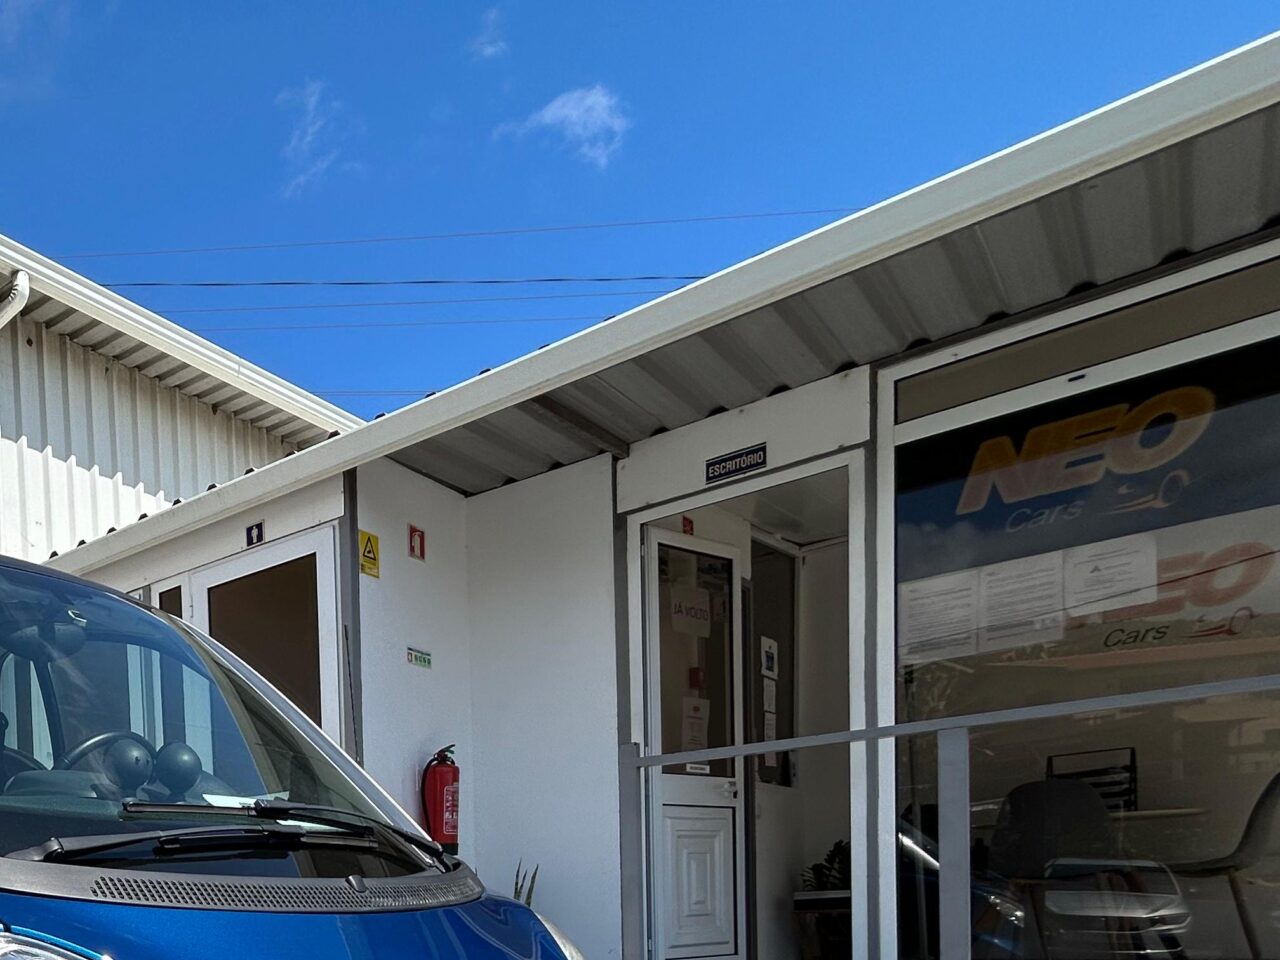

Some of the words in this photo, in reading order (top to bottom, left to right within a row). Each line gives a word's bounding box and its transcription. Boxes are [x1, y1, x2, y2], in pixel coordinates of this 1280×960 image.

[708, 451, 765, 479] ESCRITÓRIO
[955, 386, 1217, 515] NEO
[1005, 500, 1086, 534] Cars
[1104, 623, 1169, 649] Cars
